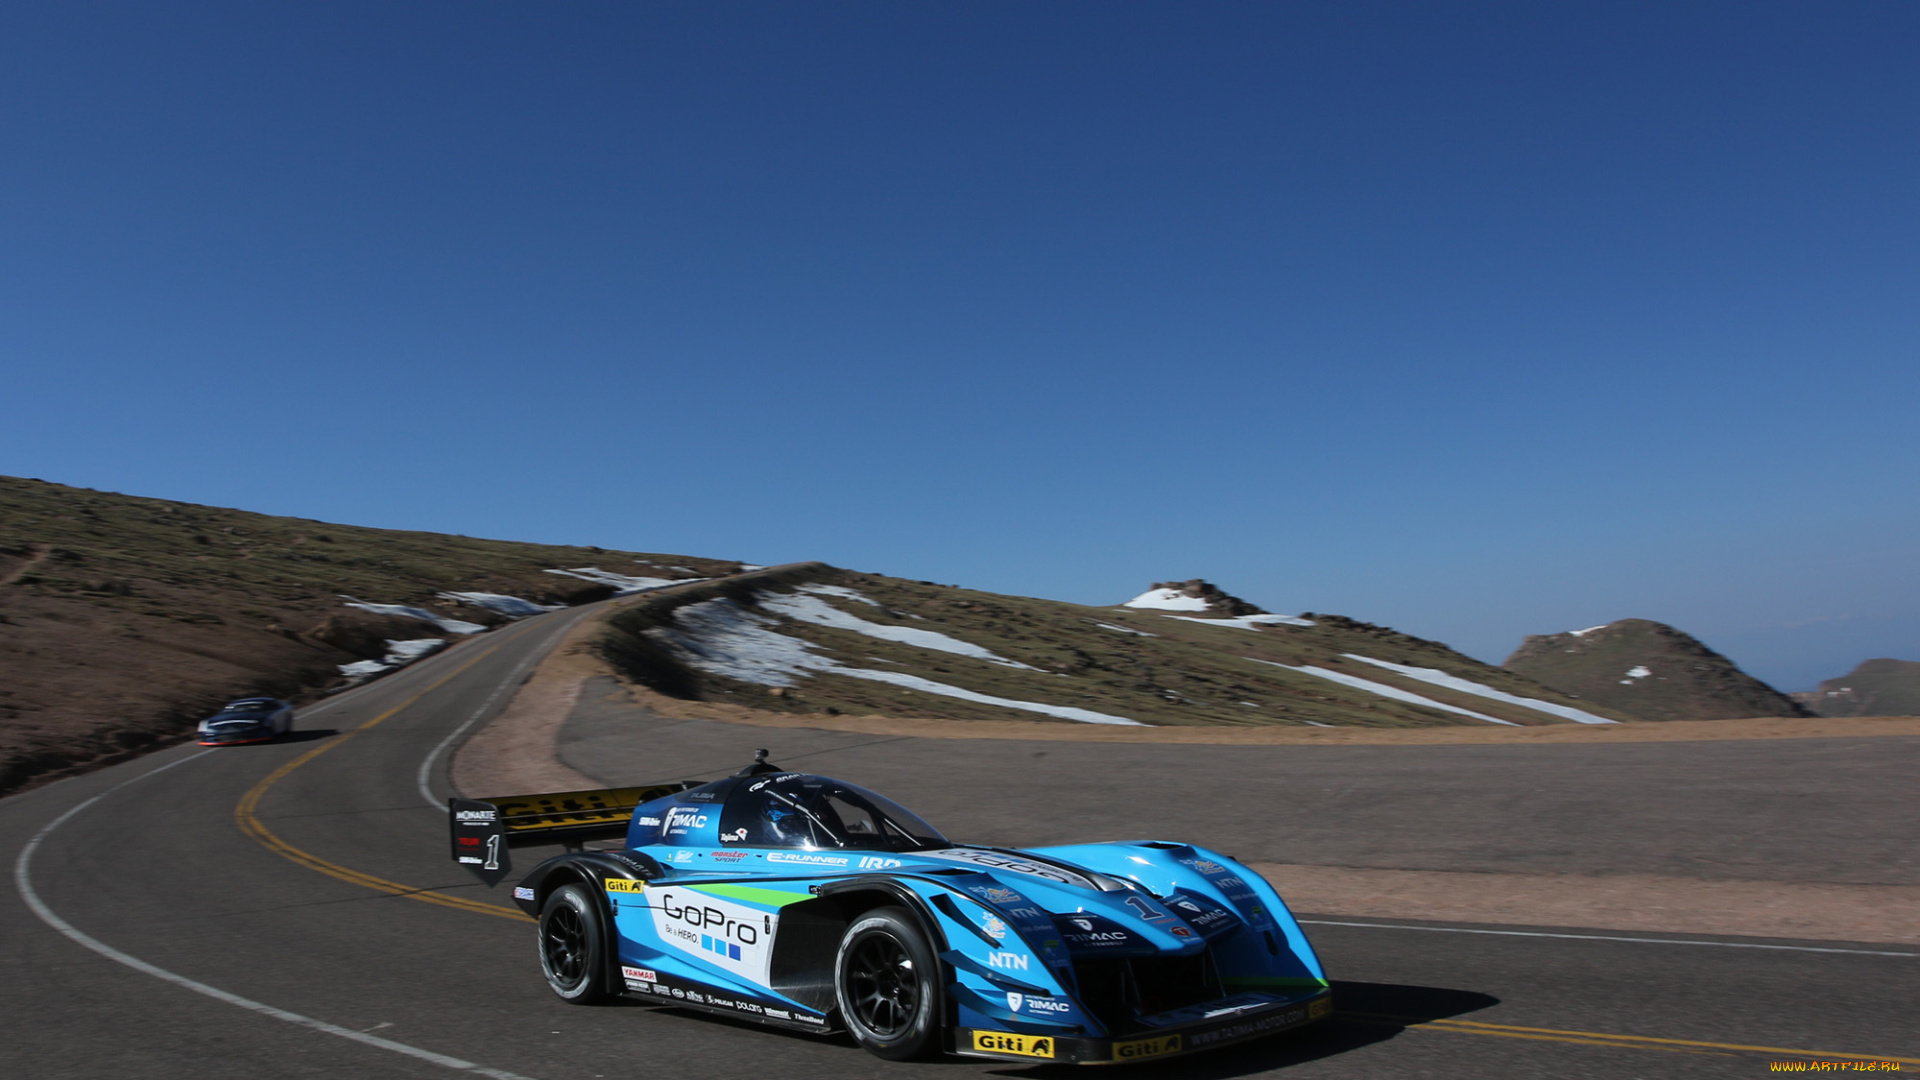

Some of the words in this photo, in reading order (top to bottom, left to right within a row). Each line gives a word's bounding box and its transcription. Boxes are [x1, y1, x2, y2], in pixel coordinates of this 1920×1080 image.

[484, 834, 500, 870] 1
[710, 850, 749, 858] monster
[766, 852, 849, 867] E-RUNNER
[607, 881, 628, 891] Giti
[1124, 896, 1166, 920] 1
[663, 894, 757, 945] GoPro
[1063, 931, 1128, 943] RIMAC
[988, 951, 1028, 971] NTN
[624, 968, 656, 980] YANMAR
[1024, 999, 1070, 1012] RIMAC
[979, 1035, 1023, 1052] Giti
[1118, 1041, 1159, 1058] Giti
